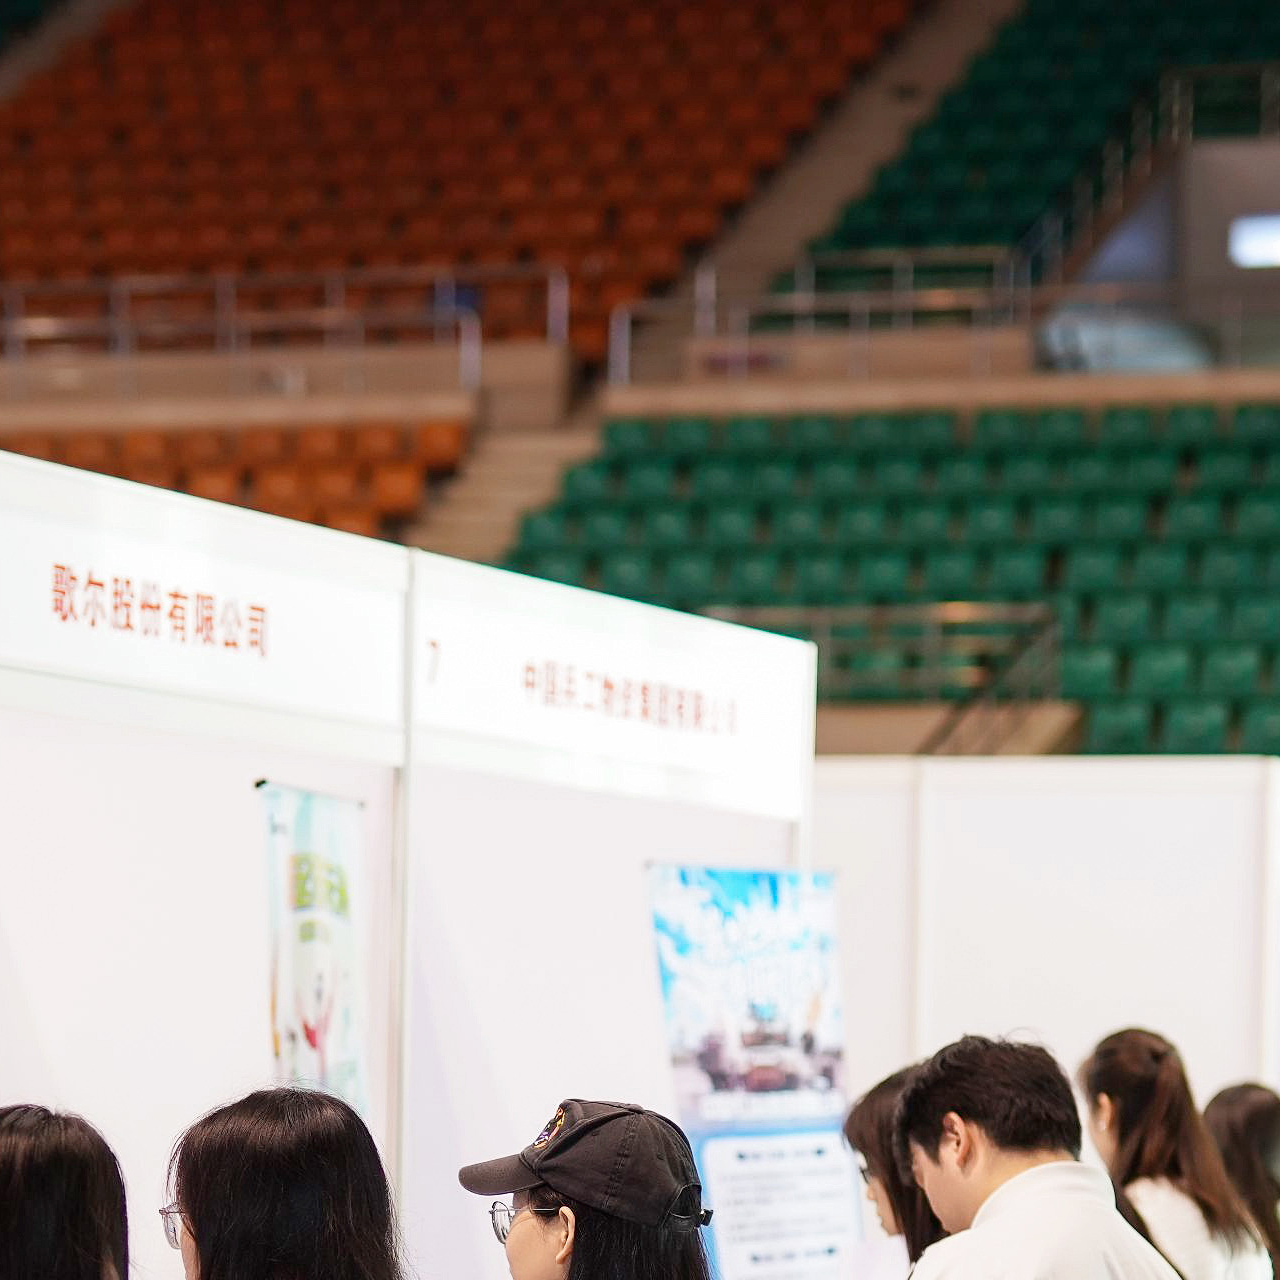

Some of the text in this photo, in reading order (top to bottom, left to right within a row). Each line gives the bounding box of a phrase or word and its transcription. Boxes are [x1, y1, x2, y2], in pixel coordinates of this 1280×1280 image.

[53, 563, 269, 657] 歌尔股份有限公司
